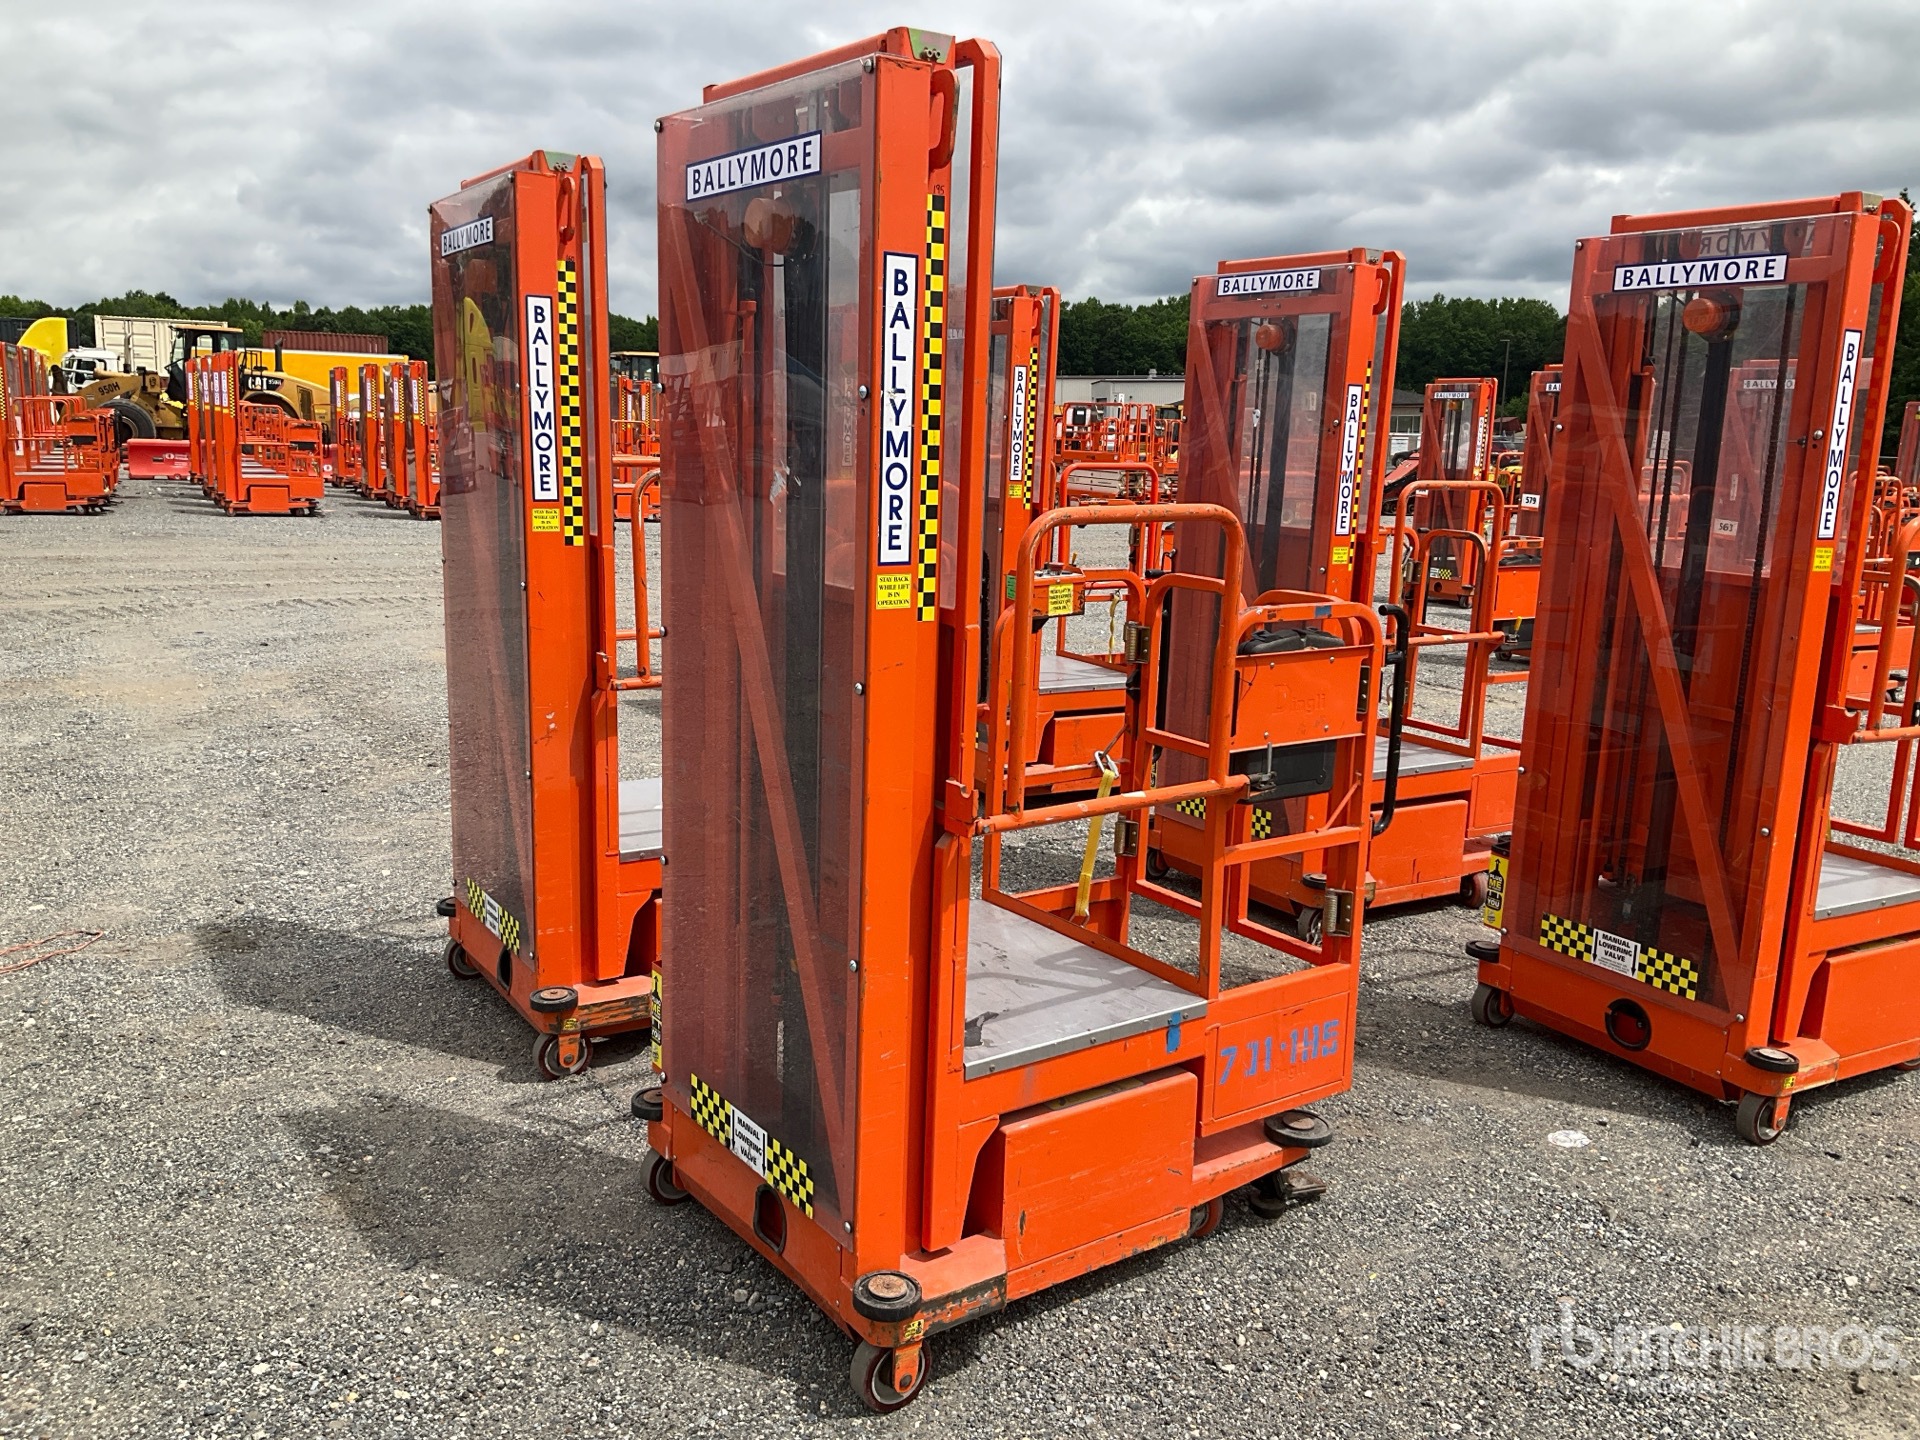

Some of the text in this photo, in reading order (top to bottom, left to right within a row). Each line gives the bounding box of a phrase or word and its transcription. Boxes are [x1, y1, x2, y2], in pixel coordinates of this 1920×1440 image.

[691, 137, 816, 196] BALLYMORE
[442, 219, 492, 254] BALLYMORE
[1222, 271, 1316, 294] BALLYMORE
[1622, 258, 1776, 288] BALLYMORE
[97, 381, 121, 396] 950H
[247, 376, 268, 390] CAT
[532, 304, 555, 493] BALLYMORE
[884, 268, 910, 551] BALLYMORE
[1011, 370, 1025, 477] BALLYMORE
[1823, 341, 1856, 532] BALLYMORE
[1340, 393, 1359, 531] BALLYMORE
[1525, 496, 1537, 505] 579
[1271, 683, 1326, 716] Dingli
[1489, 879, 1502, 888] ME
[1487, 898, 1500, 908] YOU
[1598, 939, 1633, 957] LOWERING
[1601, 932, 1631, 949] MANUAL
[1603, 949, 1626, 963] VALVE
[736, 1115, 761, 1141] MANUAL
[734, 1129, 763, 1156] LOWERING
[740, 1146, 758, 1167] VALVE
